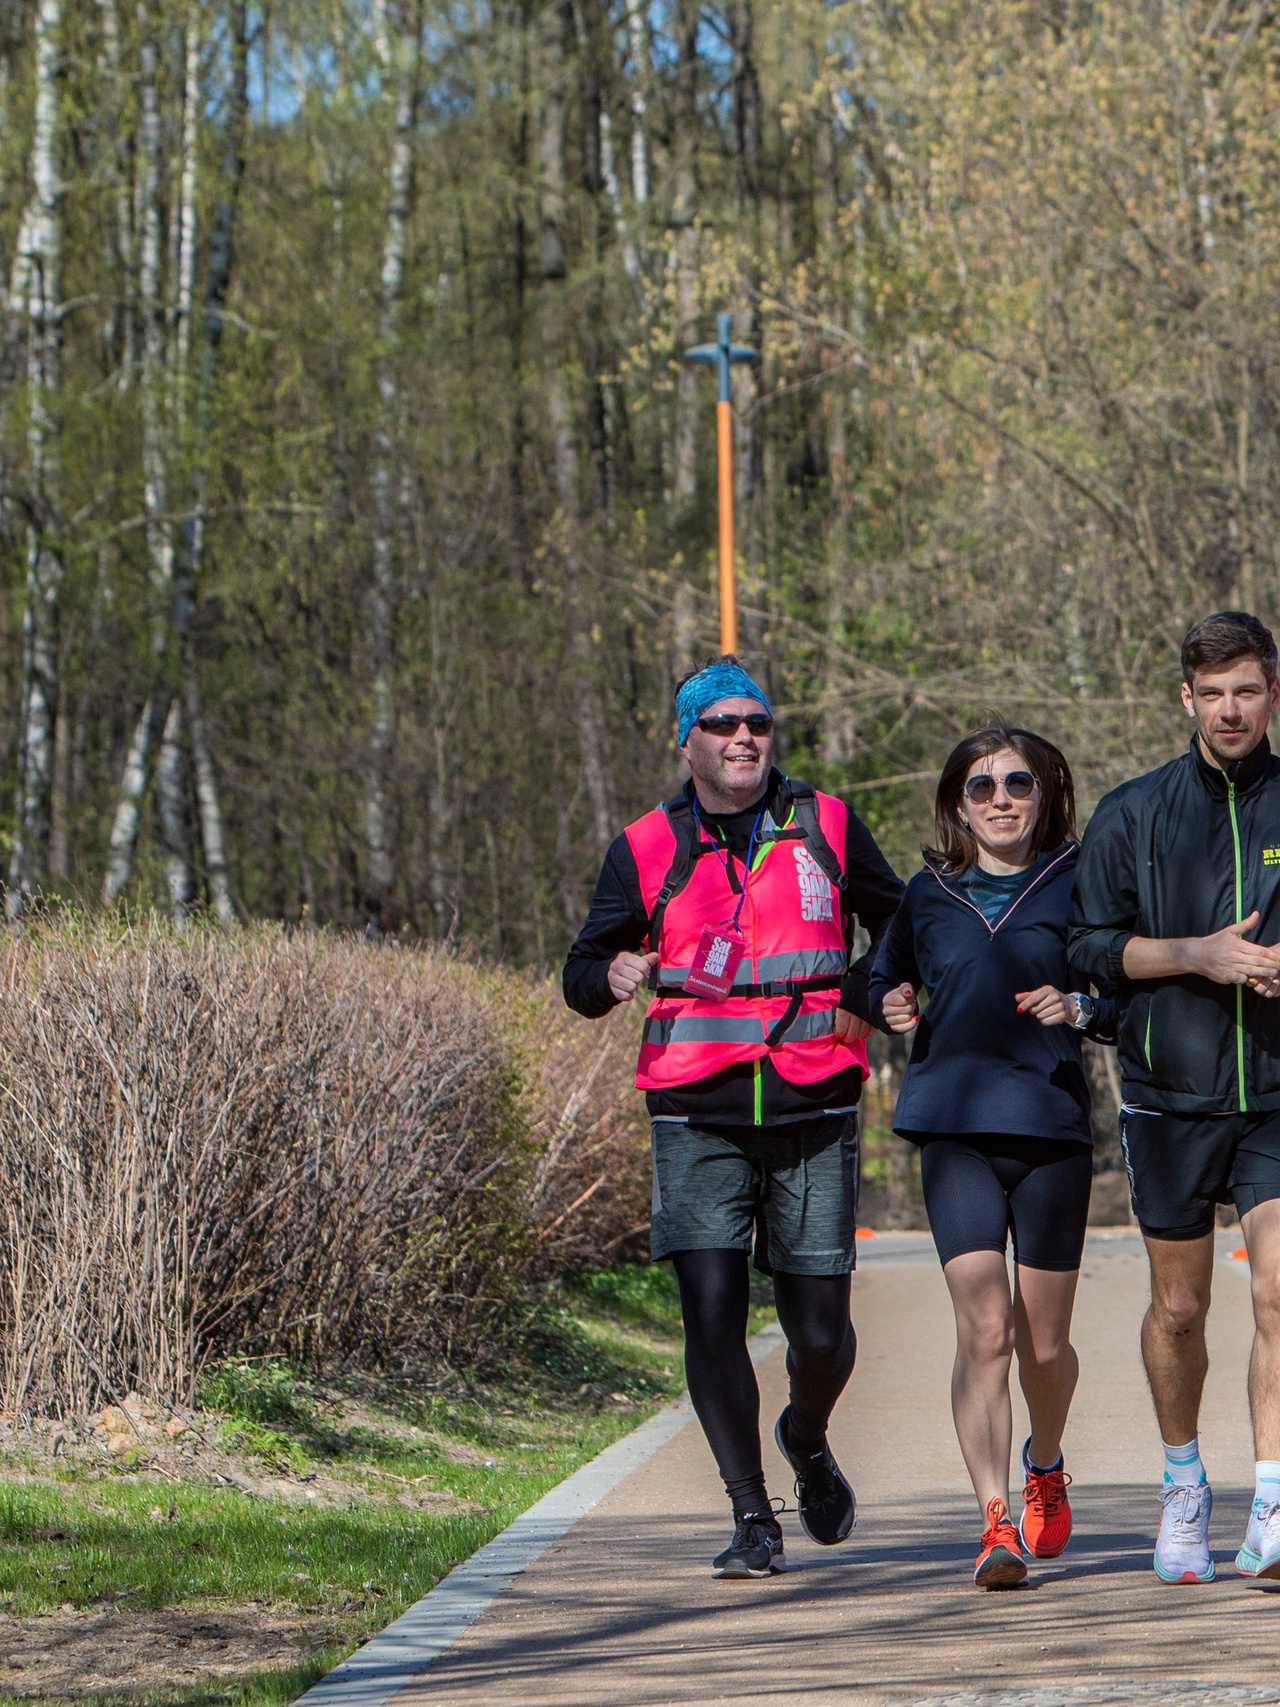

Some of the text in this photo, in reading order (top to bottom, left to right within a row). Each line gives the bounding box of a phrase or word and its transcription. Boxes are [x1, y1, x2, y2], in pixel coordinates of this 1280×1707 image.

[793, 846, 826, 876] Sa
[798, 874, 832, 899] 9AM
[801, 896, 833, 921] 5KM
[711, 936, 732, 956] Sat
[703, 960, 724, 978] 5KM
[707, 949, 728, 967] 9AM
